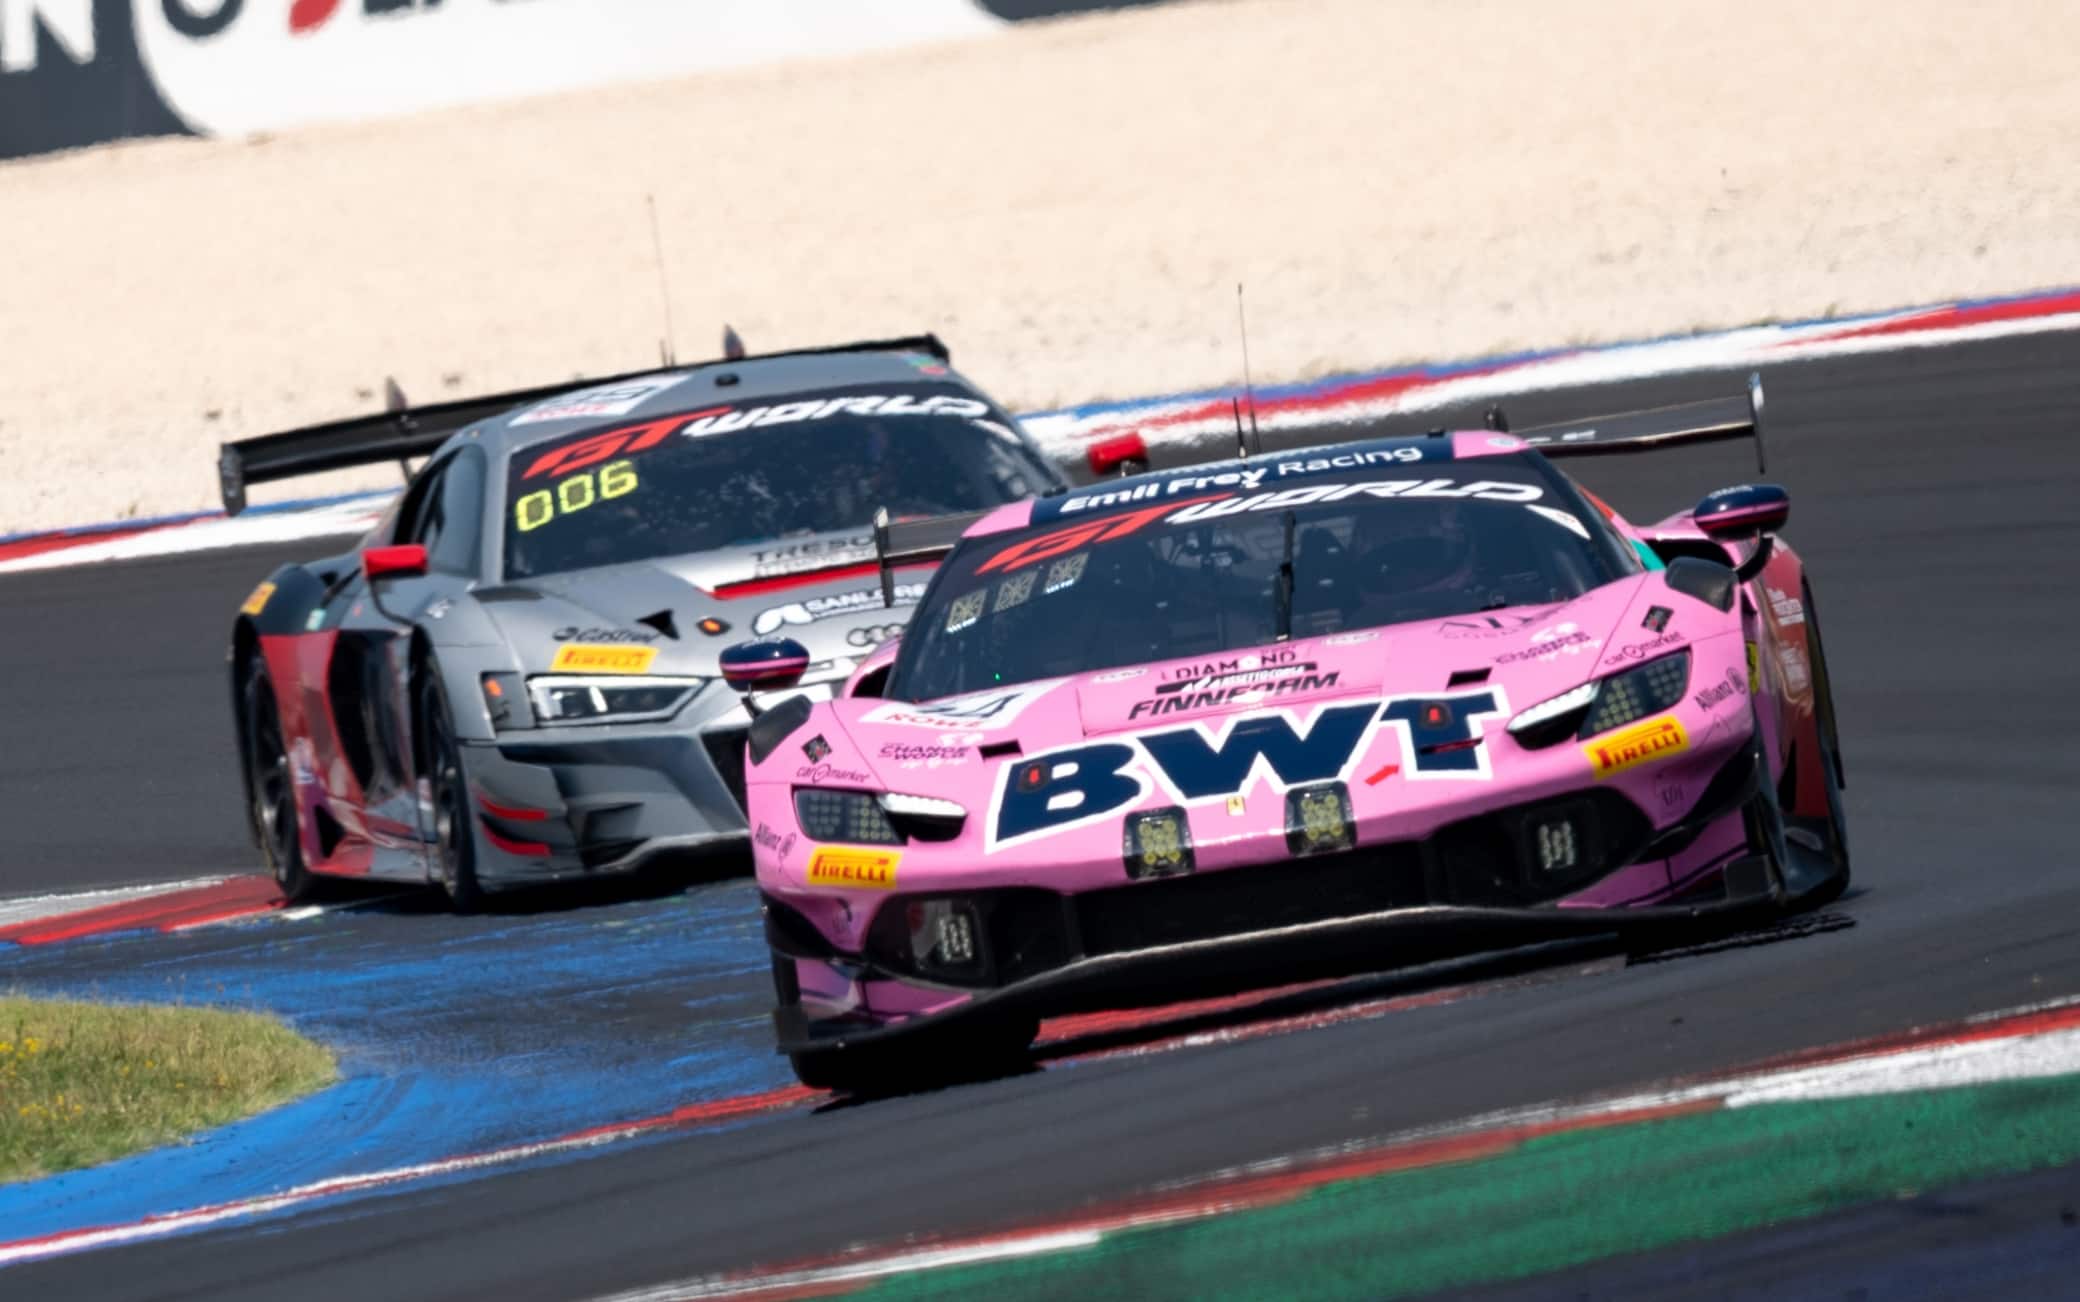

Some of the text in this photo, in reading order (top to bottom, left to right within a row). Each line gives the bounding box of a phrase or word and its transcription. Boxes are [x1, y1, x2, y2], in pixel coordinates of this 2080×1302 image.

[681, 396, 989, 437] WORLD
[516, 459, 639, 532] 006
[1060, 446, 1423, 512] Emil Frey Racing
[1164, 479, 1544, 524] WORLD
[562, 650, 647, 667] PIRELLI
[994, 690, 1500, 844] BWT
[1596, 723, 1682, 769] PIRELLI
[812, 853, 890, 882] PIRELLI
